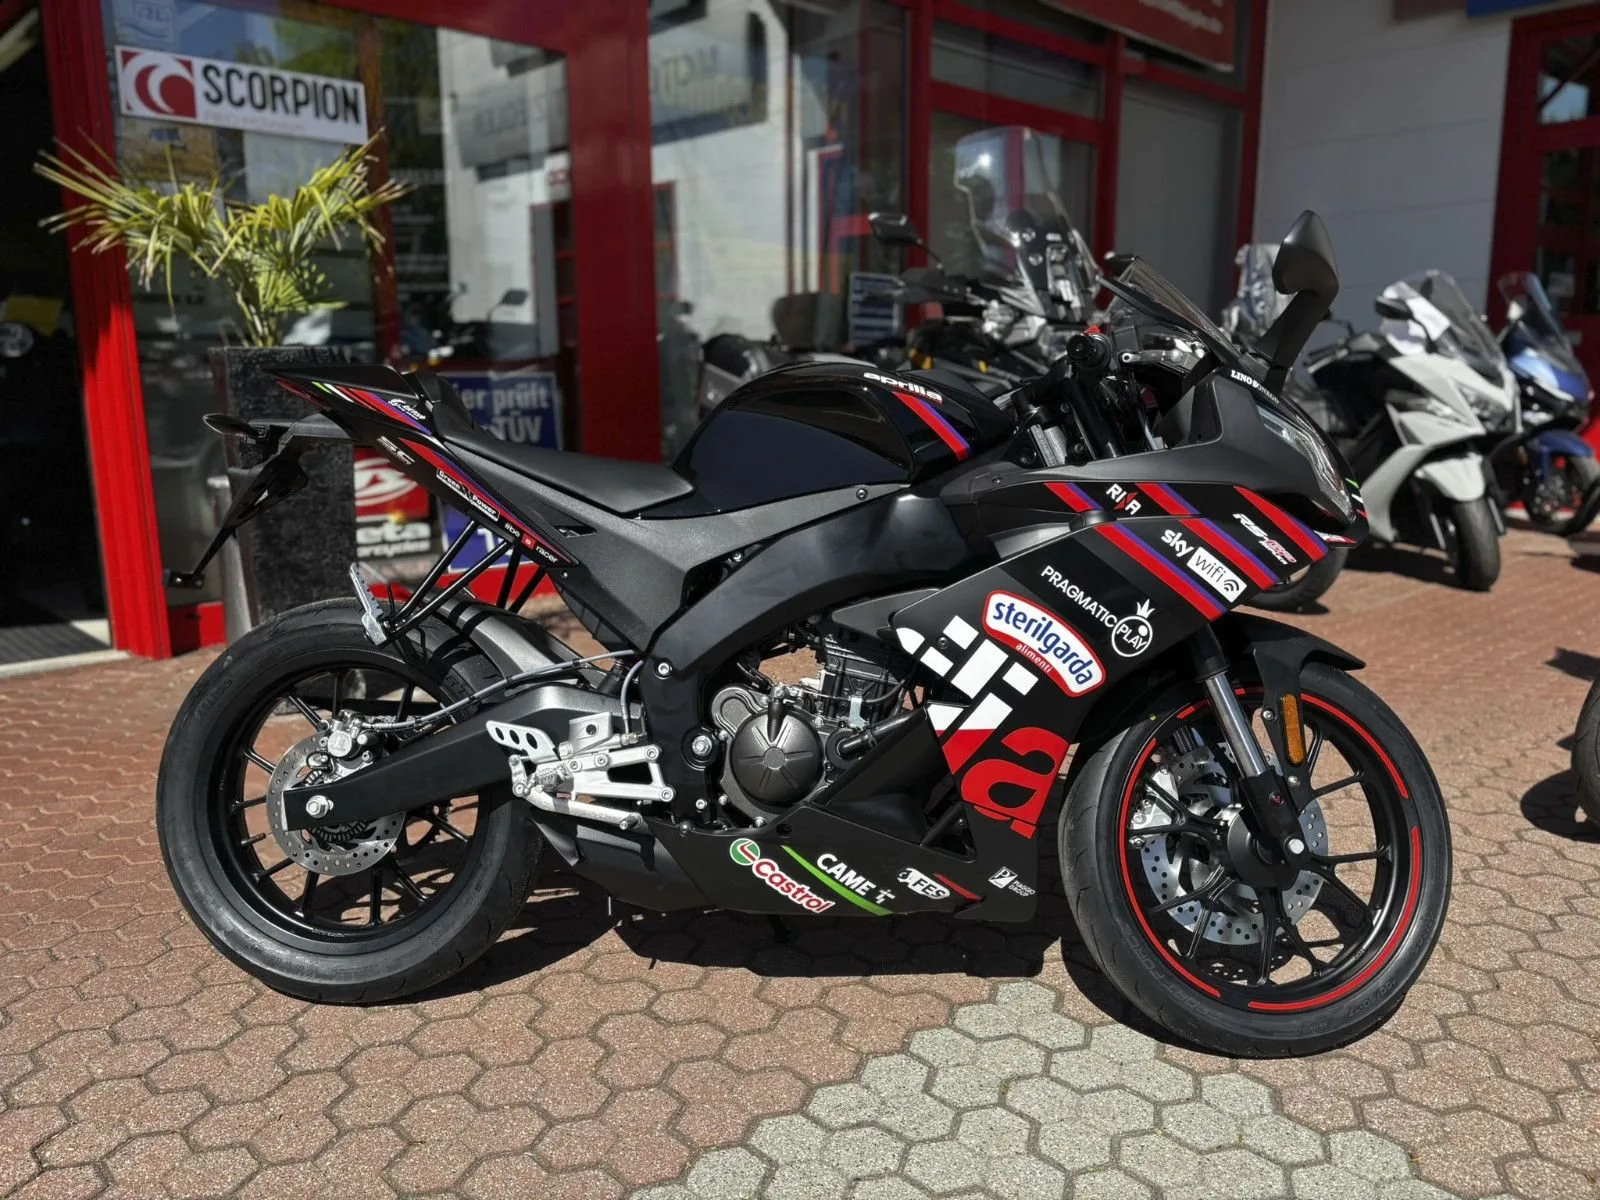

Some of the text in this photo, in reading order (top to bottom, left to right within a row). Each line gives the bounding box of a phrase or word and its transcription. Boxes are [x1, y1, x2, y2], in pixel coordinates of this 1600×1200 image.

[202, 64, 360, 124] SCORPION
[863, 372, 943, 404] aprilia
[439, 470, 497, 516] Green Power
[356, 521, 431, 545] eta
[535, 545, 558, 563] racer
[1161, 529, 1225, 583] sky wifi
[1040, 565, 1147, 650] PRAGMATIC PLAY
[992, 602, 1094, 686] sterilgarda
[1015, 642, 1053, 674] alimenti
[752, 858, 836, 914] Castrol
[816, 853, 877, 896] CAME
[912, 877, 946, 898] FES
